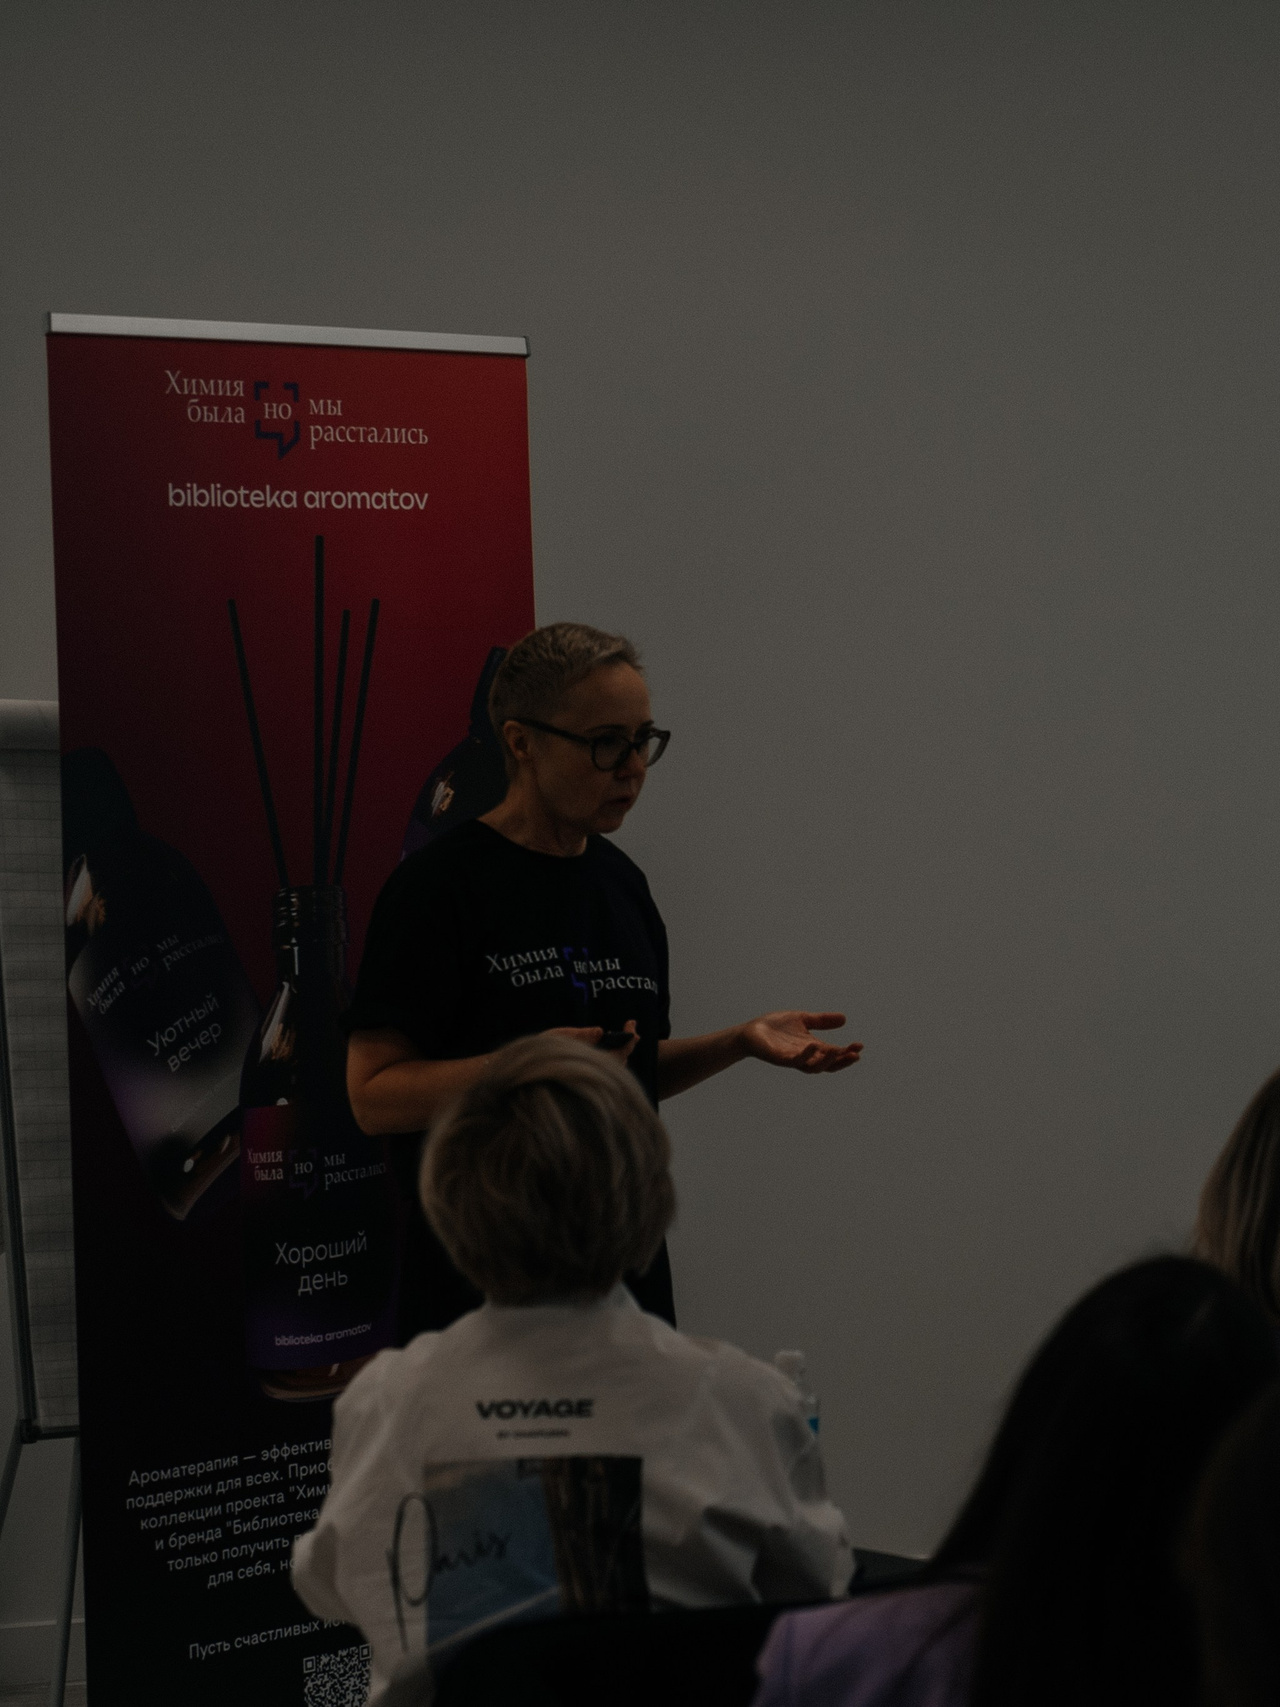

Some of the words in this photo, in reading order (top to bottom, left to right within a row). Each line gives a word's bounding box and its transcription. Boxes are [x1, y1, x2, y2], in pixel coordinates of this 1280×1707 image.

[164, 370, 245, 396] Химия
[187, 398, 246, 423] была
[263, 402, 292, 420] но
[309, 398, 343, 416] мы
[309, 424, 429, 450] расстались
[168, 482, 298, 508] biblioteka
[303, 488, 429, 510] aromatov
[130, 957, 150, 976] но
[486, 947, 559, 974] Химия
[589, 958, 622, 973] мы
[510, 964, 565, 987] была
[146, 992, 220, 1057] Уютный
[167, 1023, 222, 1072] вечер
[254, 1165, 284, 1181] была
[294, 1161, 313, 1175] но
[324, 1153, 346, 1168] мы
[275, 1230, 368, 1269] Хороший
[298, 1270, 349, 1296] день
[274, 1333, 323, 1347] biblioteka
[324, 1322, 373, 1342] aromatov
[475, 1399, 594, 1419] VOYAGE
[128, 1454, 239, 1488] Ароматерапия
[126, 1484, 213, 1510] поддержки
[215, 1477, 242, 1496] для
[245, 1470, 284, 1487] всех.
[140, 1506, 223, 1531] коллекции
[226, 1491, 285, 1515] проекта
[154, 1538, 164, 1551] и
[168, 1526, 222, 1550] бренда
[226, 1508, 320, 1536] "Библиотека
[167, 1551, 218, 1572] только
[221, 1535, 290, 1558] получить
[207, 1570, 234, 1589] для
[237, 1559, 276, 1580] себя,
[188, 1640, 231, 1660] Пусть
[234, 1619, 320, 1649] счастливых
